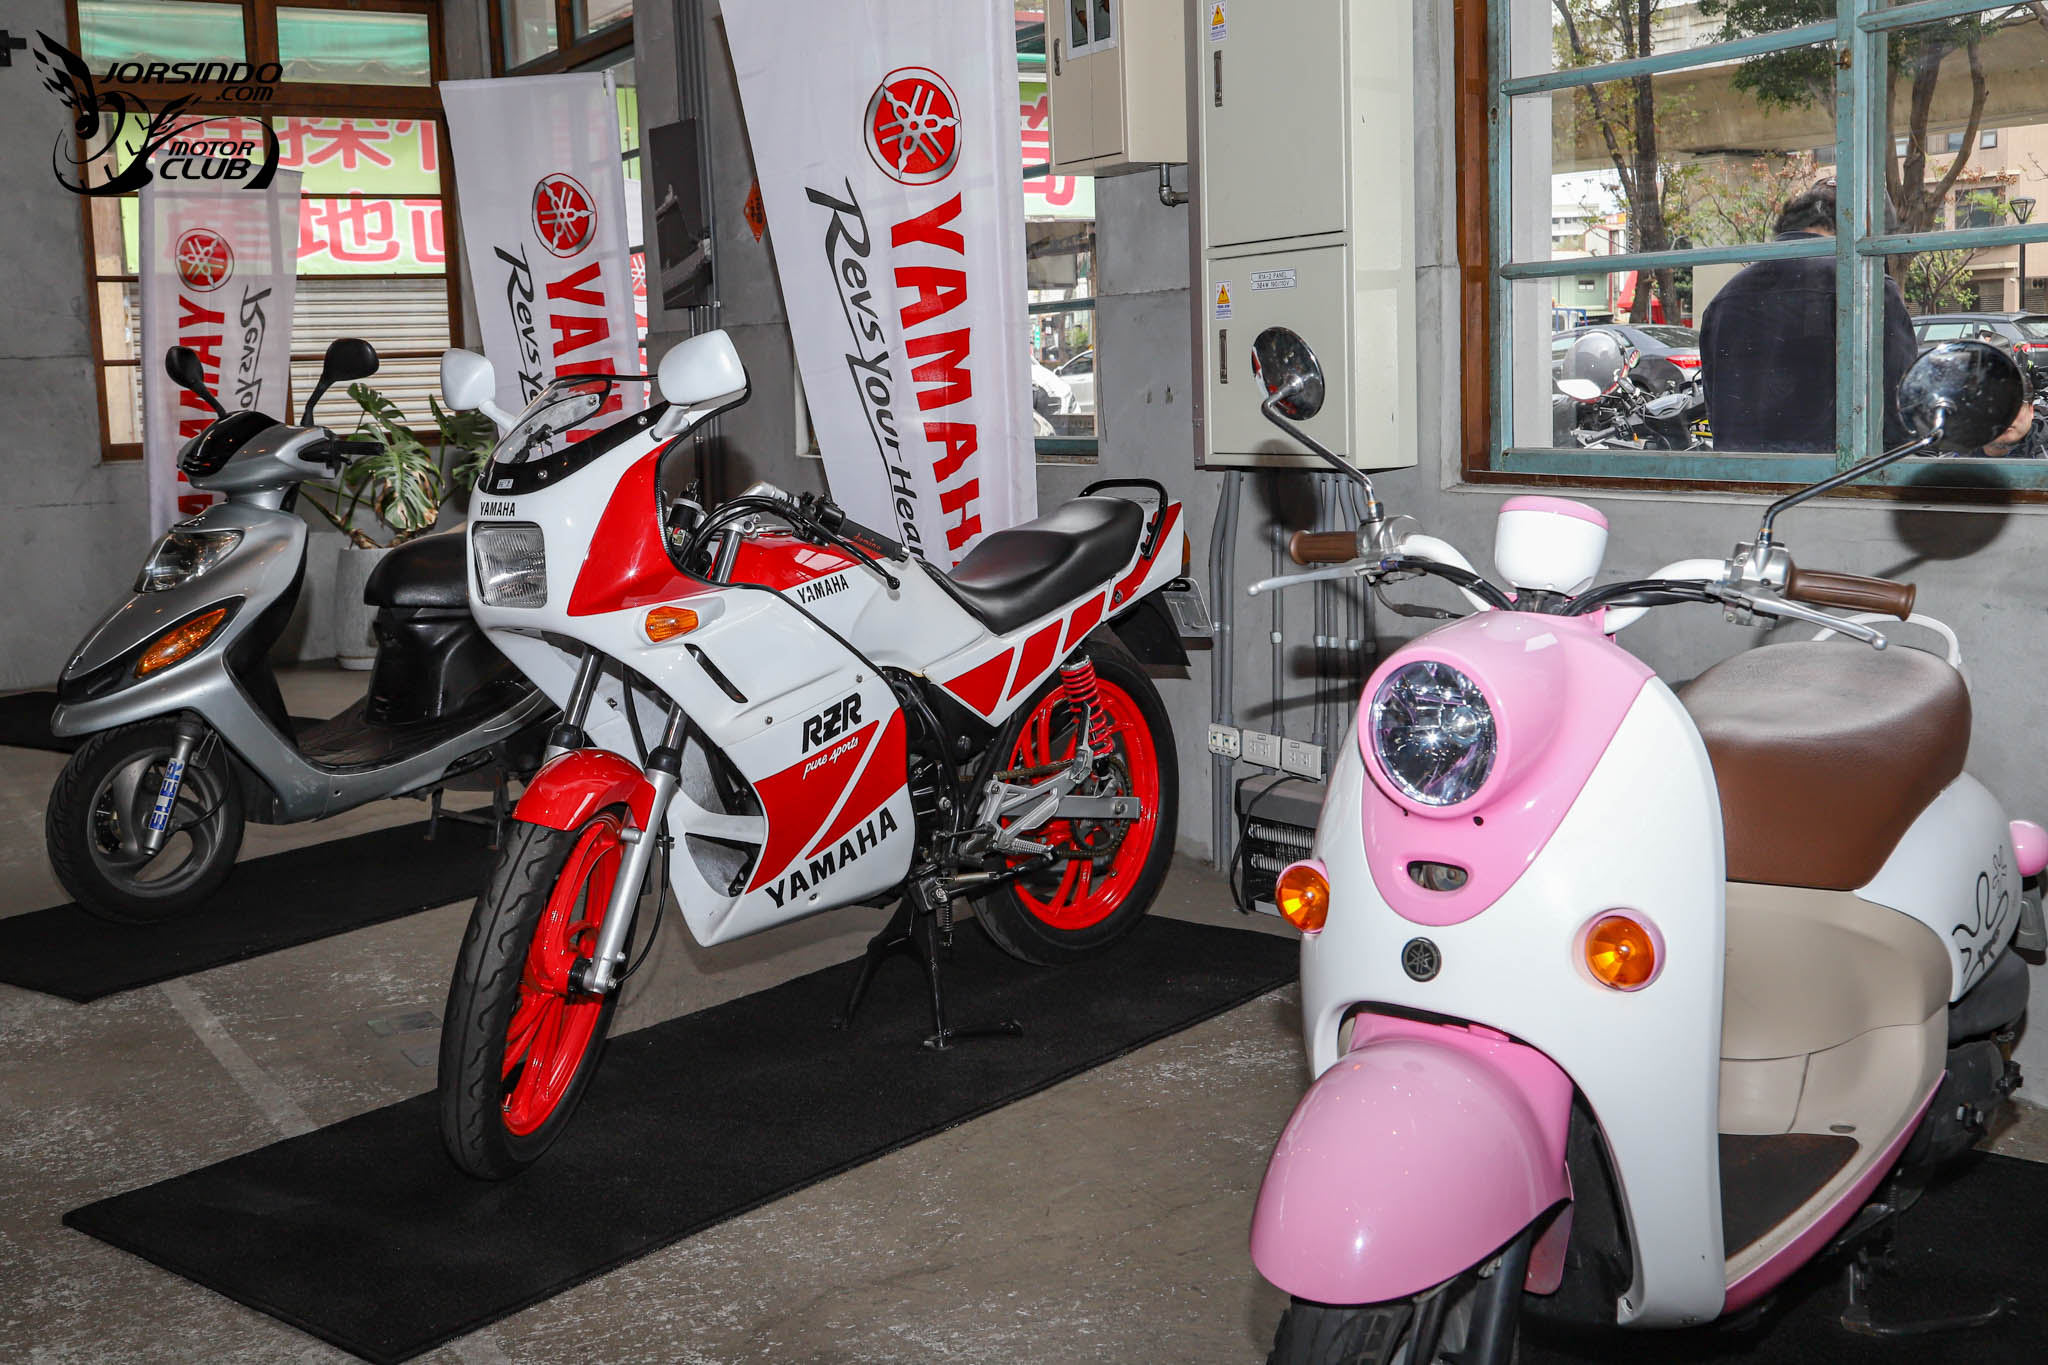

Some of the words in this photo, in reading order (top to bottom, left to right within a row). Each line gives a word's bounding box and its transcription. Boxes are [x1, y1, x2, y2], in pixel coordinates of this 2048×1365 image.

[805, 175, 886, 347] Revs
[845, 350, 903, 464] Your
[890, 191, 983, 568] YAMAH
[480, 501, 516, 517] YAMAHA
[797, 574, 850, 605] YAMAHA
[801, 692, 862, 755] RZR
[802, 754, 828, 781] pure
[828, 736, 860, 764] sports
[765, 806, 898, 910] YAMAHA
